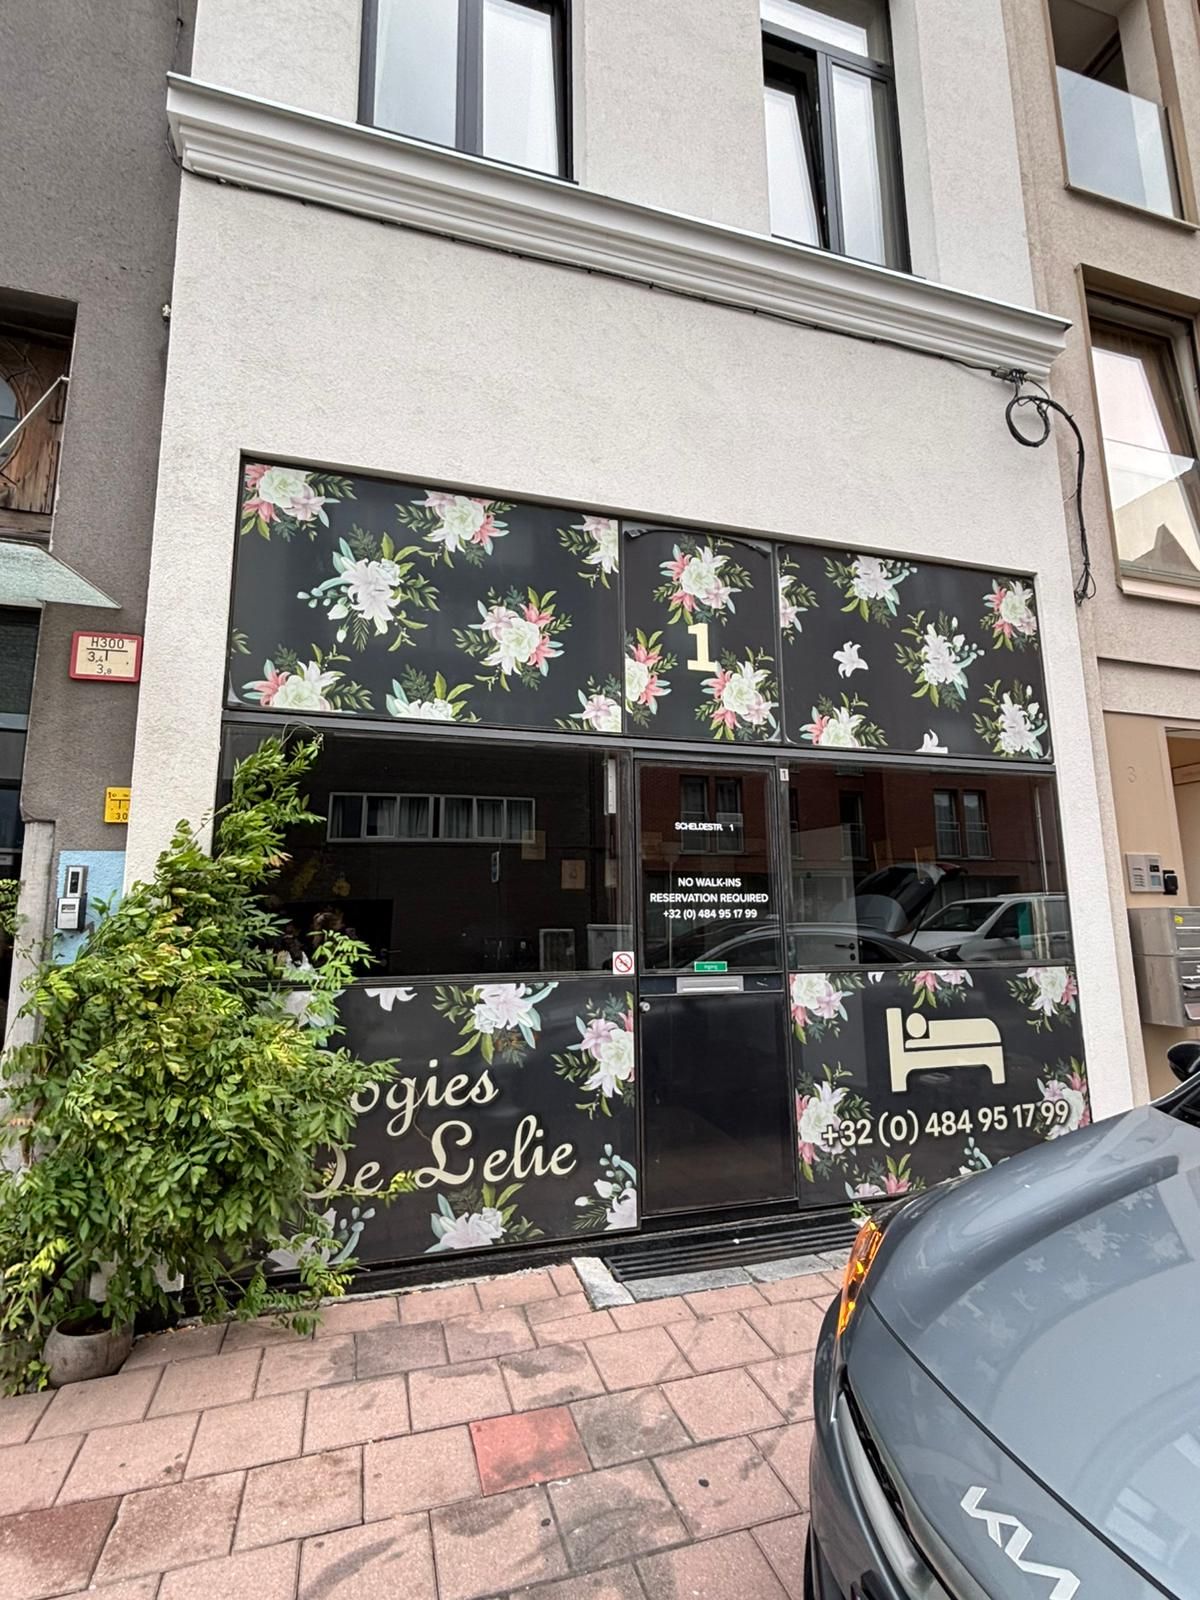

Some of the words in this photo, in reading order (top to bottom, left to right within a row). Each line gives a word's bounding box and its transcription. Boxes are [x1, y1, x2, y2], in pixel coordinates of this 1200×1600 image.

[91, 636, 125, 649] H300
[687, 622, 718, 672] 1
[729, 823, 735, 832] 1
[677, 877, 694, 887] NO
[695, 877, 742, 888] WALK-INS
[649, 892, 718, 903] RESERVATION
[720, 893, 769, 903] REQUIRED
[663, 909, 681, 919] +32
[683, 908, 696, 920] (0)
[698, 909, 717, 919] 484
[719, 909, 732, 919] 95
[733, 909, 743, 919] 17
[744, 908, 758, 919] 99
[316, 1050, 499, 1137] ogies
[821, 1119, 873, 1147] +32
[878, 1109, 919, 1148] (0)
[925, 1109, 973, 1137] 484
[977, 1106, 1008, 1132] 95
[1012, 1103, 1035, 1128] 17
[1040, 1100, 1069, 1125] 99
[414, 1114, 576, 1189] Lelie
